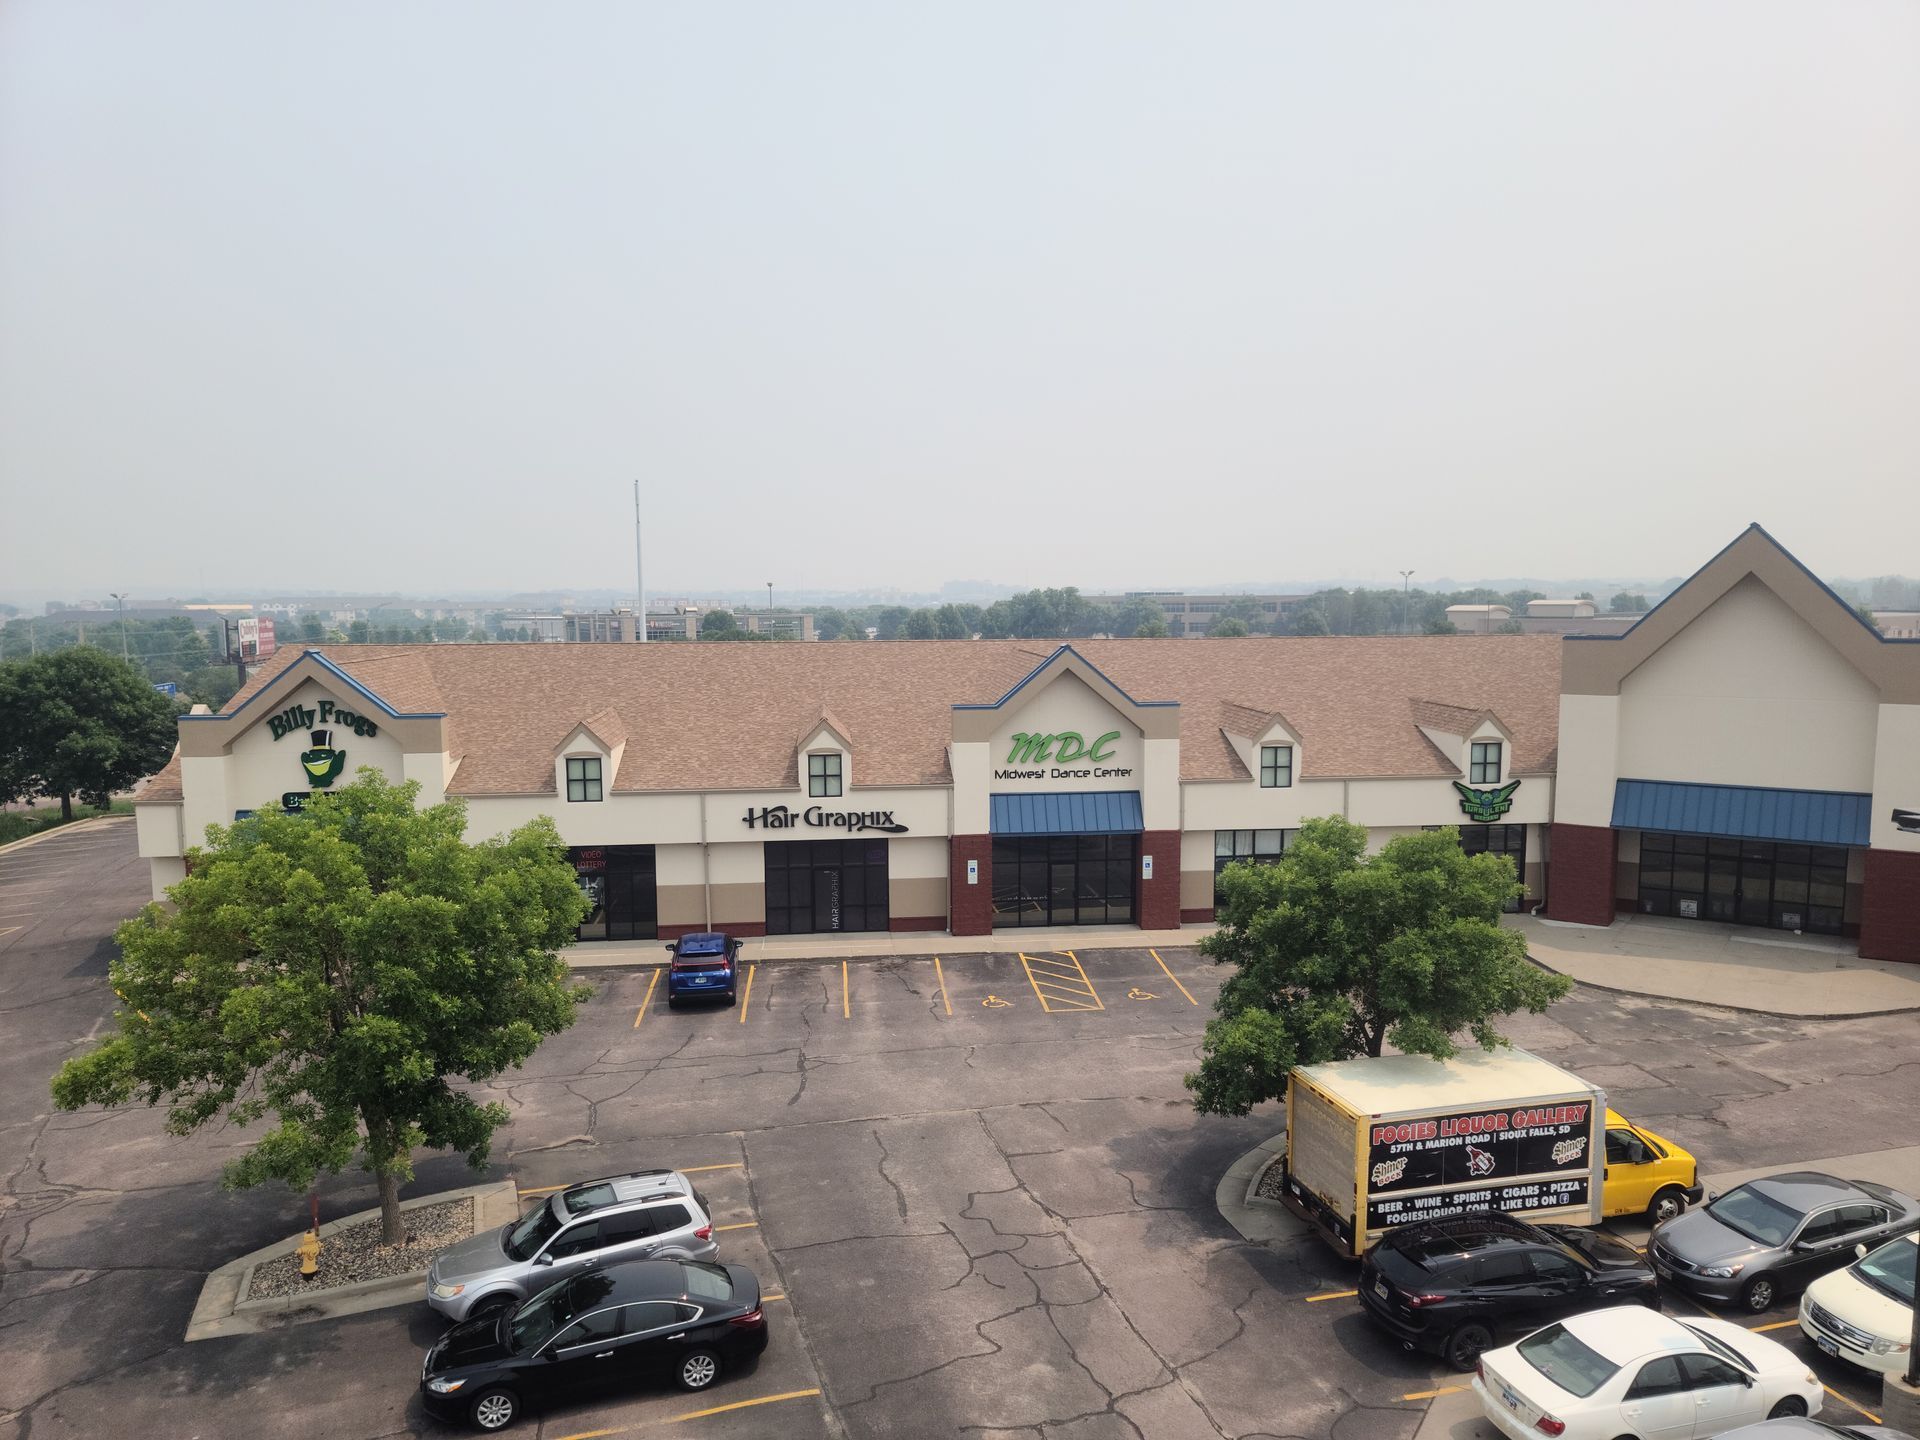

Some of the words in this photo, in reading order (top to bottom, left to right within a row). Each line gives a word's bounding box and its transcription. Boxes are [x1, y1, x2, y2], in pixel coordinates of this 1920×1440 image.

[266, 704, 316, 741] Billy
[317, 700, 378, 738] Frogs
[1007, 730, 1121, 763] MDC
[994, 768, 1046, 780] Midwest
[1051, 768, 1091, 779] Dance
[1094, 767, 1133, 778] Center
[742, 805, 799, 828] Hair
[1463, 802, 1511, 816] TURBULENT
[576, 860, 607, 869] LOTTERY
[580, 850, 602, 859] VIDEO
[1373, 1121, 1438, 1146] FOGIES
[1441, 1113, 1509, 1137] LIQUOR
[1512, 1104, 1588, 1129] GALLERY
[1390, 1143, 1413, 1154] 57TH
[1416, 1141, 1423, 1150] &
[1425, 1137, 1463, 1149] MARION
[1465, 1133, 1490, 1144] ROAD
[1499, 1129, 1527, 1141] SIOUX
[1529, 1126, 1557, 1137] FALLS,
[1558, 1125, 1571, 1135] SD
[1552, 1136, 1587, 1160] Shiner
[1558, 1150, 1582, 1164] BOCK
[1371, 1157, 1408, 1182] Shiner
[1377, 1171, 1402, 1186] BOCK
[1378, 1202, 1403, 1213] BEER
[1414, 1197, 1442, 1208] WINE
[1453, 1191, 1491, 1204] SPIRITS
[1502, 1185, 1539, 1198] CIGARS
[1550, 1181, 1580, 1192] PIZZA
[1501, 1199, 1523, 1210] LIKE
[1525, 1197, 1538, 1207] US
[1541, 1195, 1557, 1206] ON
